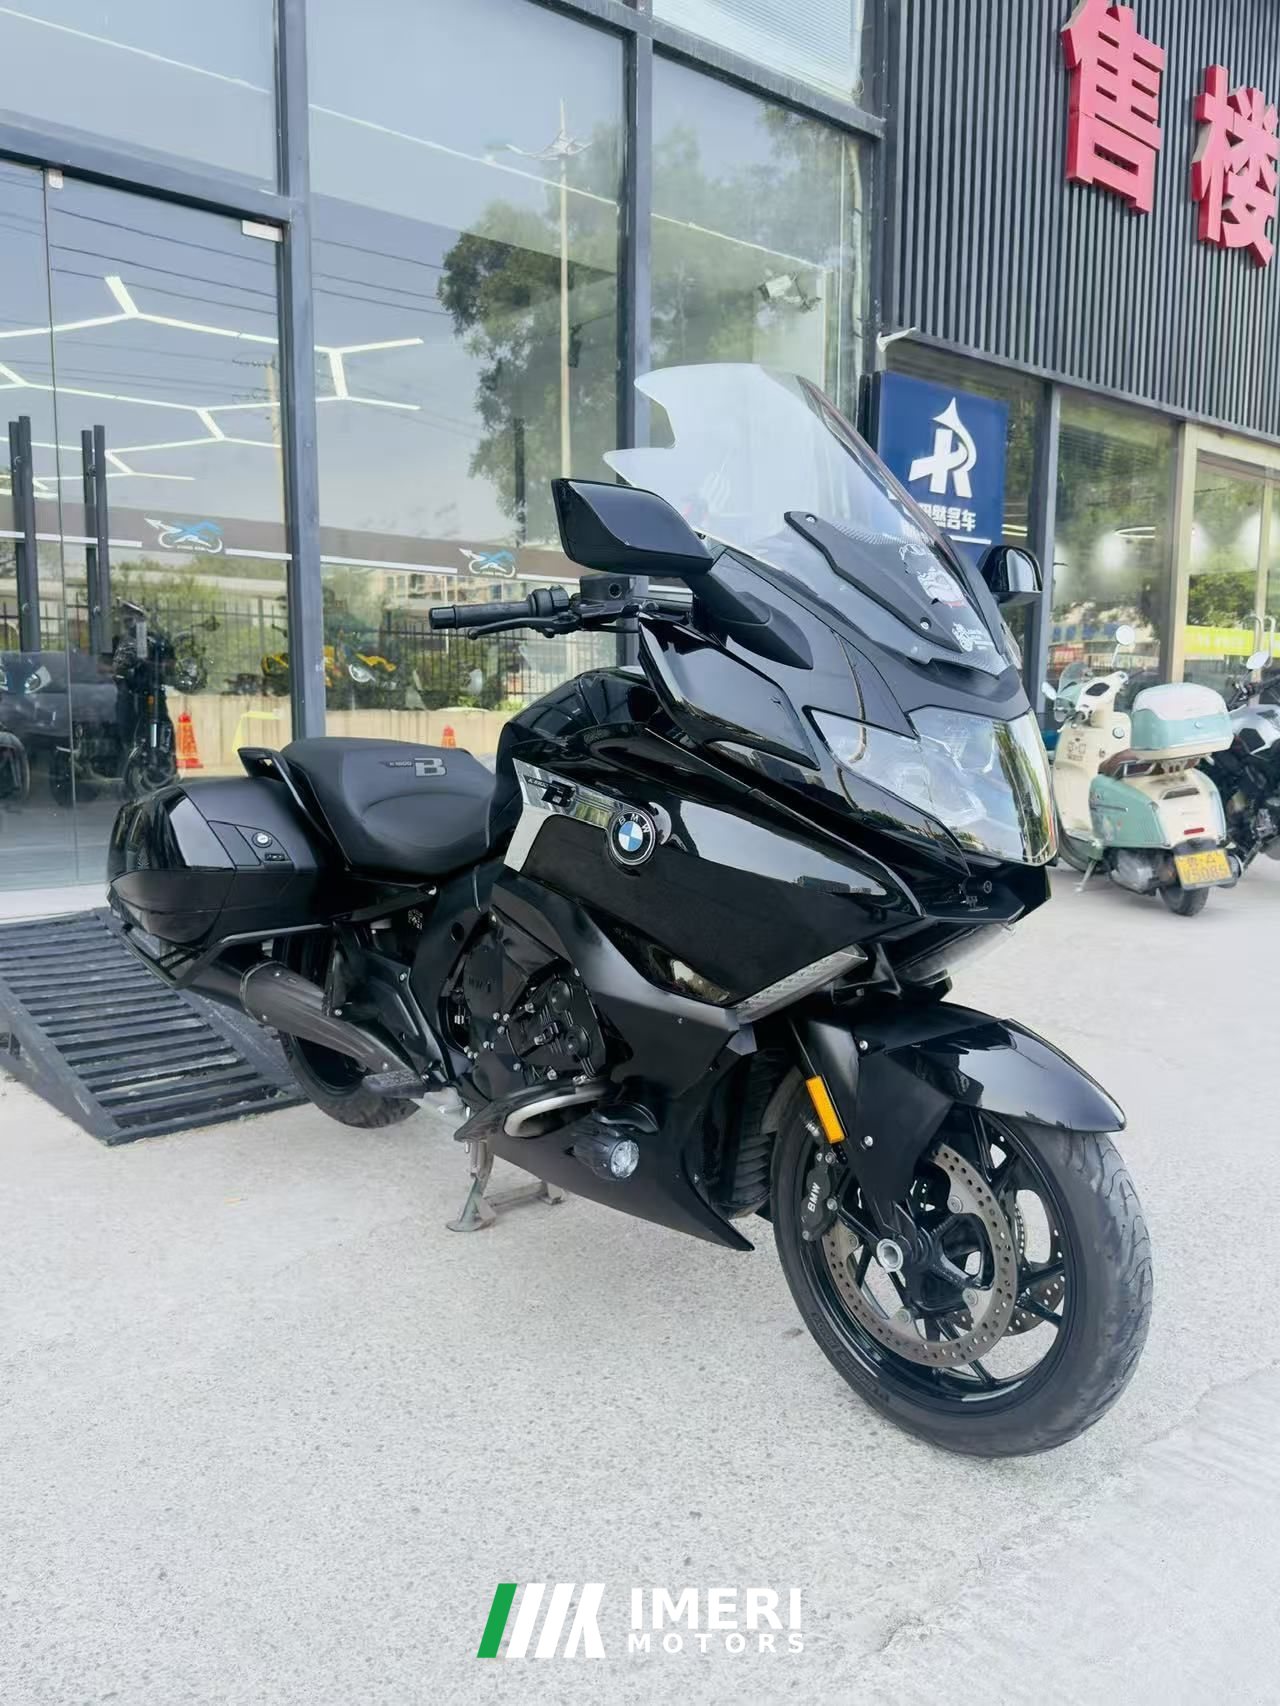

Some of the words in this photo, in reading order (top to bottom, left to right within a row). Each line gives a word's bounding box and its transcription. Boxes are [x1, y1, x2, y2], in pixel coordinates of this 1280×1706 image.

[1060, 0, 1280, 269] 售楼
[414, 757, 446, 777] B
[618, 812, 650, 833] BMW
[807, 1181, 821, 1213] BMW
